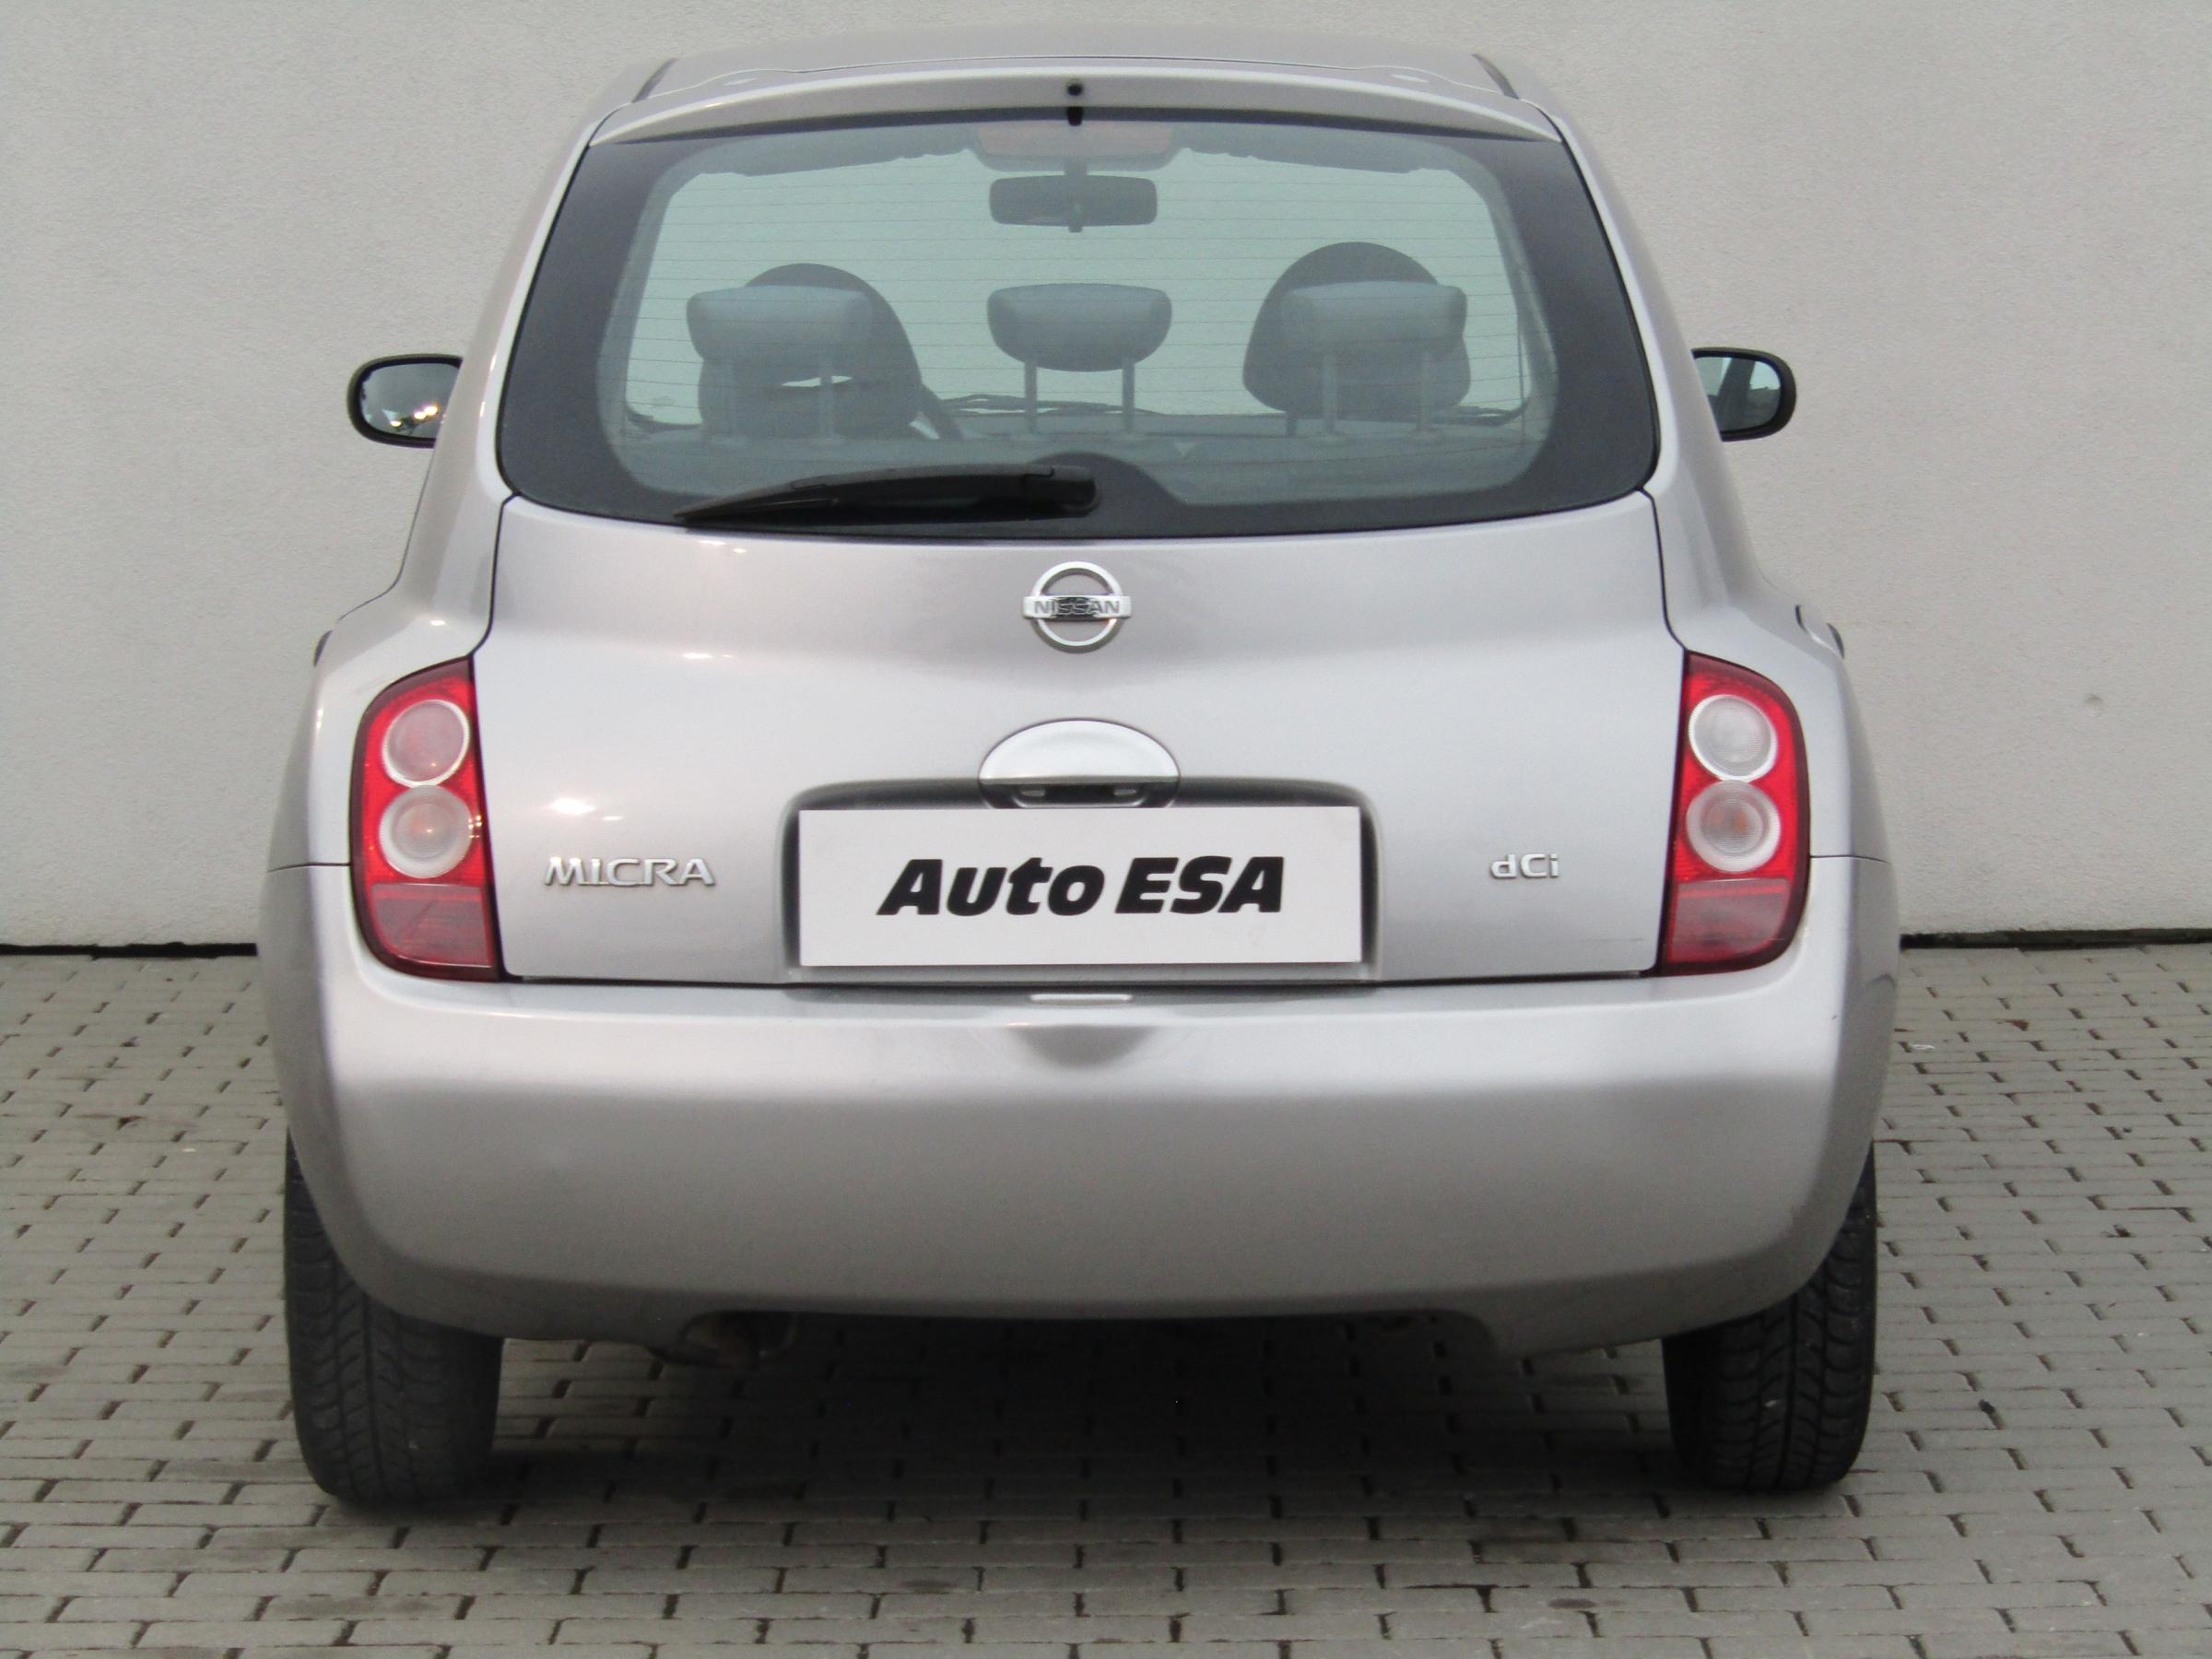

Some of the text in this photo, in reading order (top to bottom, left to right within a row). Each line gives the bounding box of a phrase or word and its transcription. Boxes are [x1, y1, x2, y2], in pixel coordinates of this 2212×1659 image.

[1033, 599, 1121, 616] NISSAN
[545, 856, 715, 886] MICRA
[1489, 853, 1559, 879] dCi
[877, 855, 1284, 917] Auto ESA
